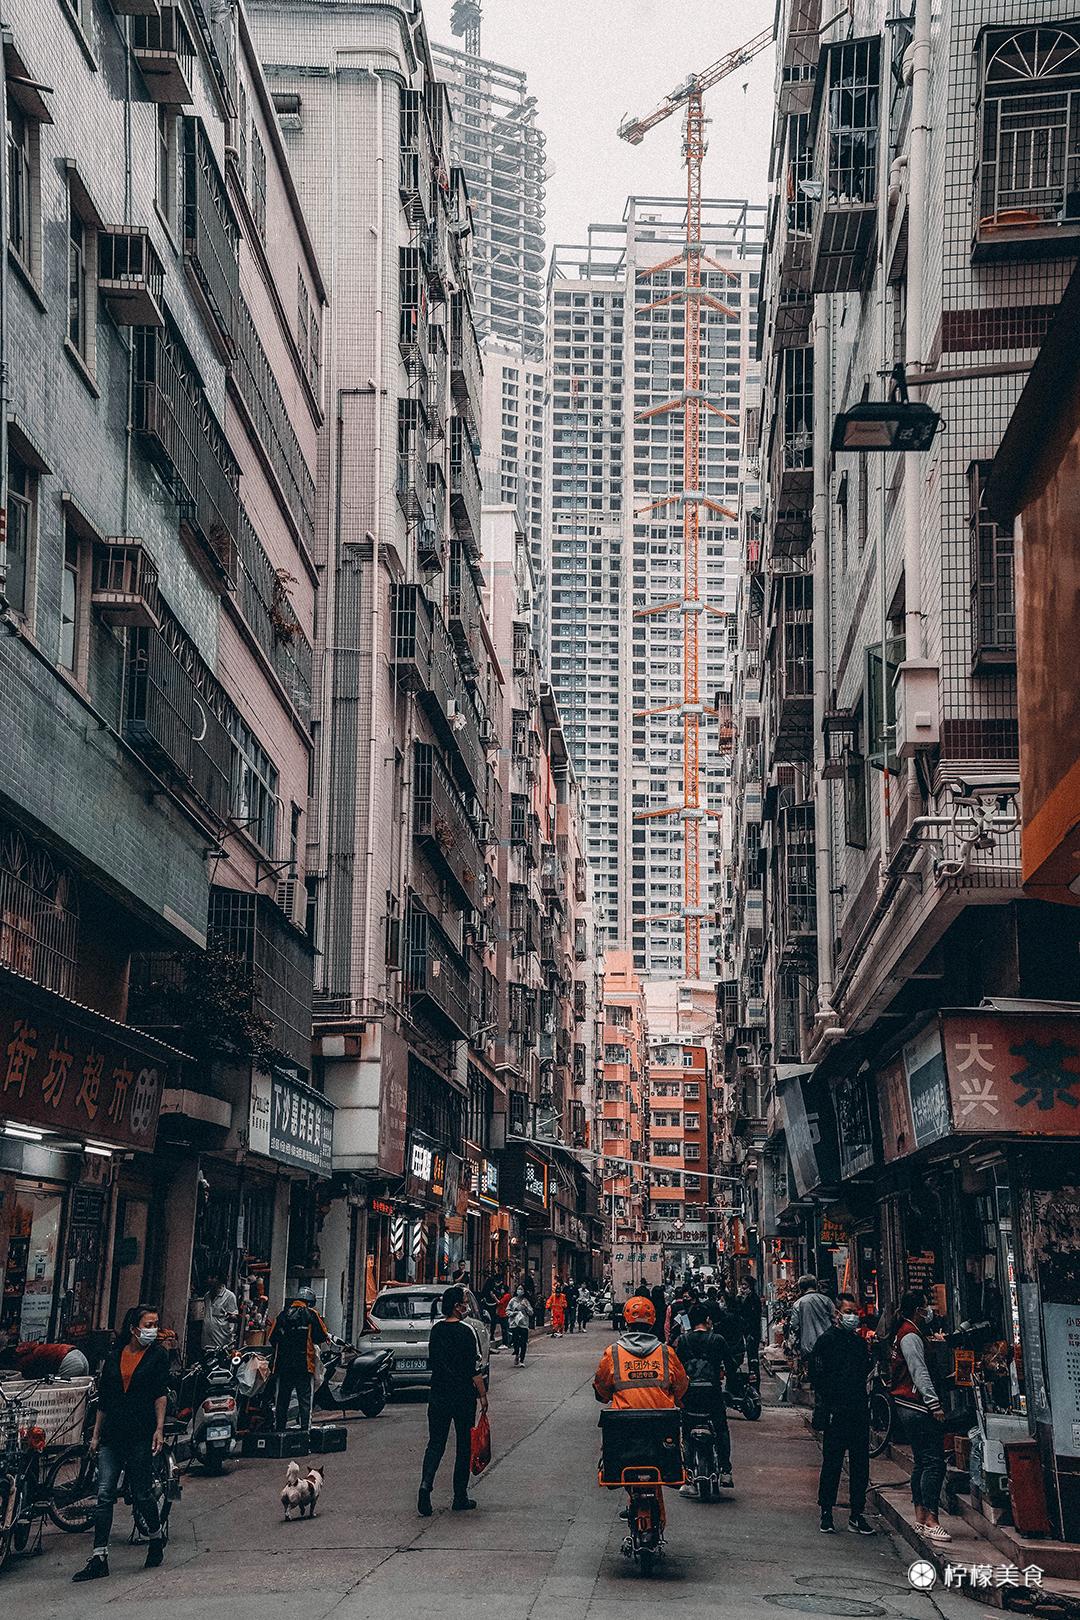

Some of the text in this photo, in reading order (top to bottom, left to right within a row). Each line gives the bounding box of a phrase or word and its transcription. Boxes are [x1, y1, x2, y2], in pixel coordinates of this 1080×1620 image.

[3, 1019, 134, 1124] 街坊超市
[955, 1033, 999, 1116] 大兴
[1009, 1039, 1080, 1111] 茶
[624, 1360, 661, 1371] 美团外卖
